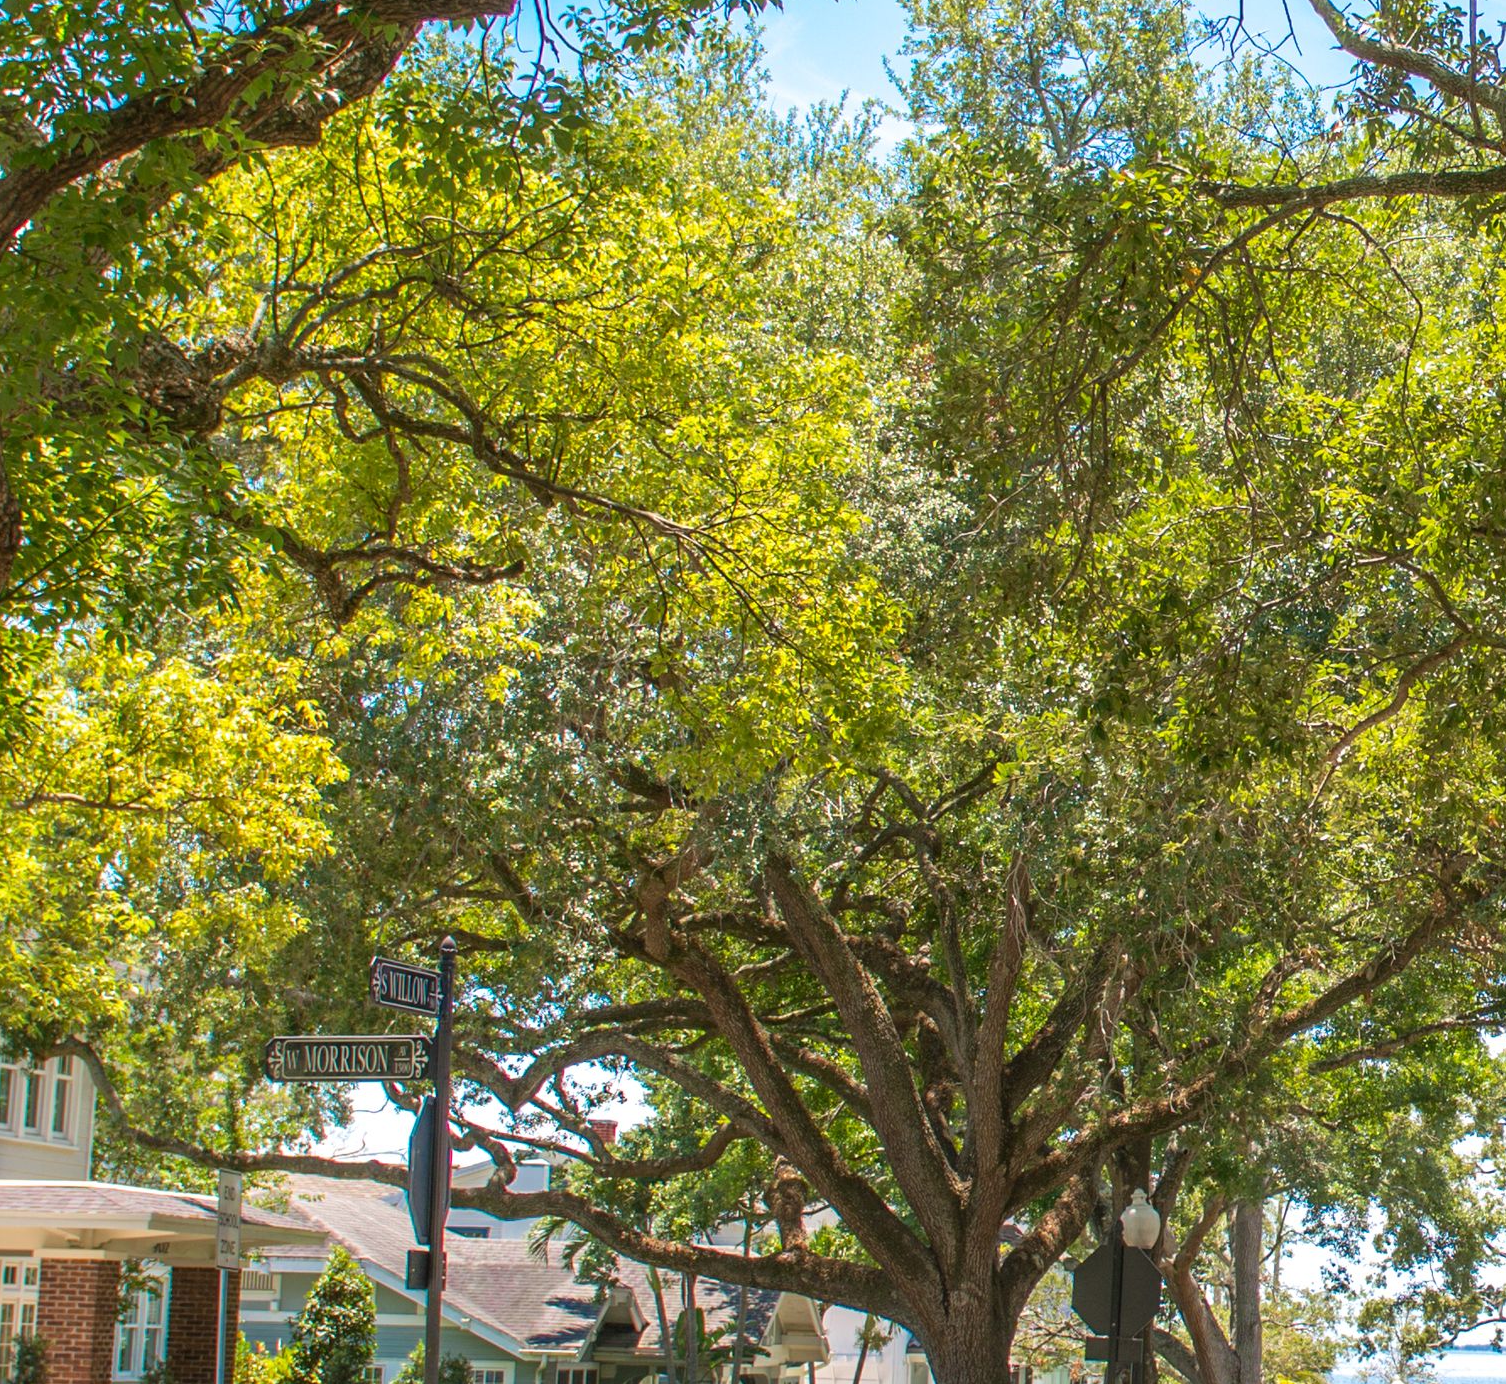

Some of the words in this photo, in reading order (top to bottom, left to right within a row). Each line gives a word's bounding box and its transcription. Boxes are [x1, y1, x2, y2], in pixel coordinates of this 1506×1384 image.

[381, 973, 388, 995] S
[389, 970, 429, 1005] WILLOW
[286, 1049, 300, 1070] W
[304, 1044, 389, 1073] MORRISON
